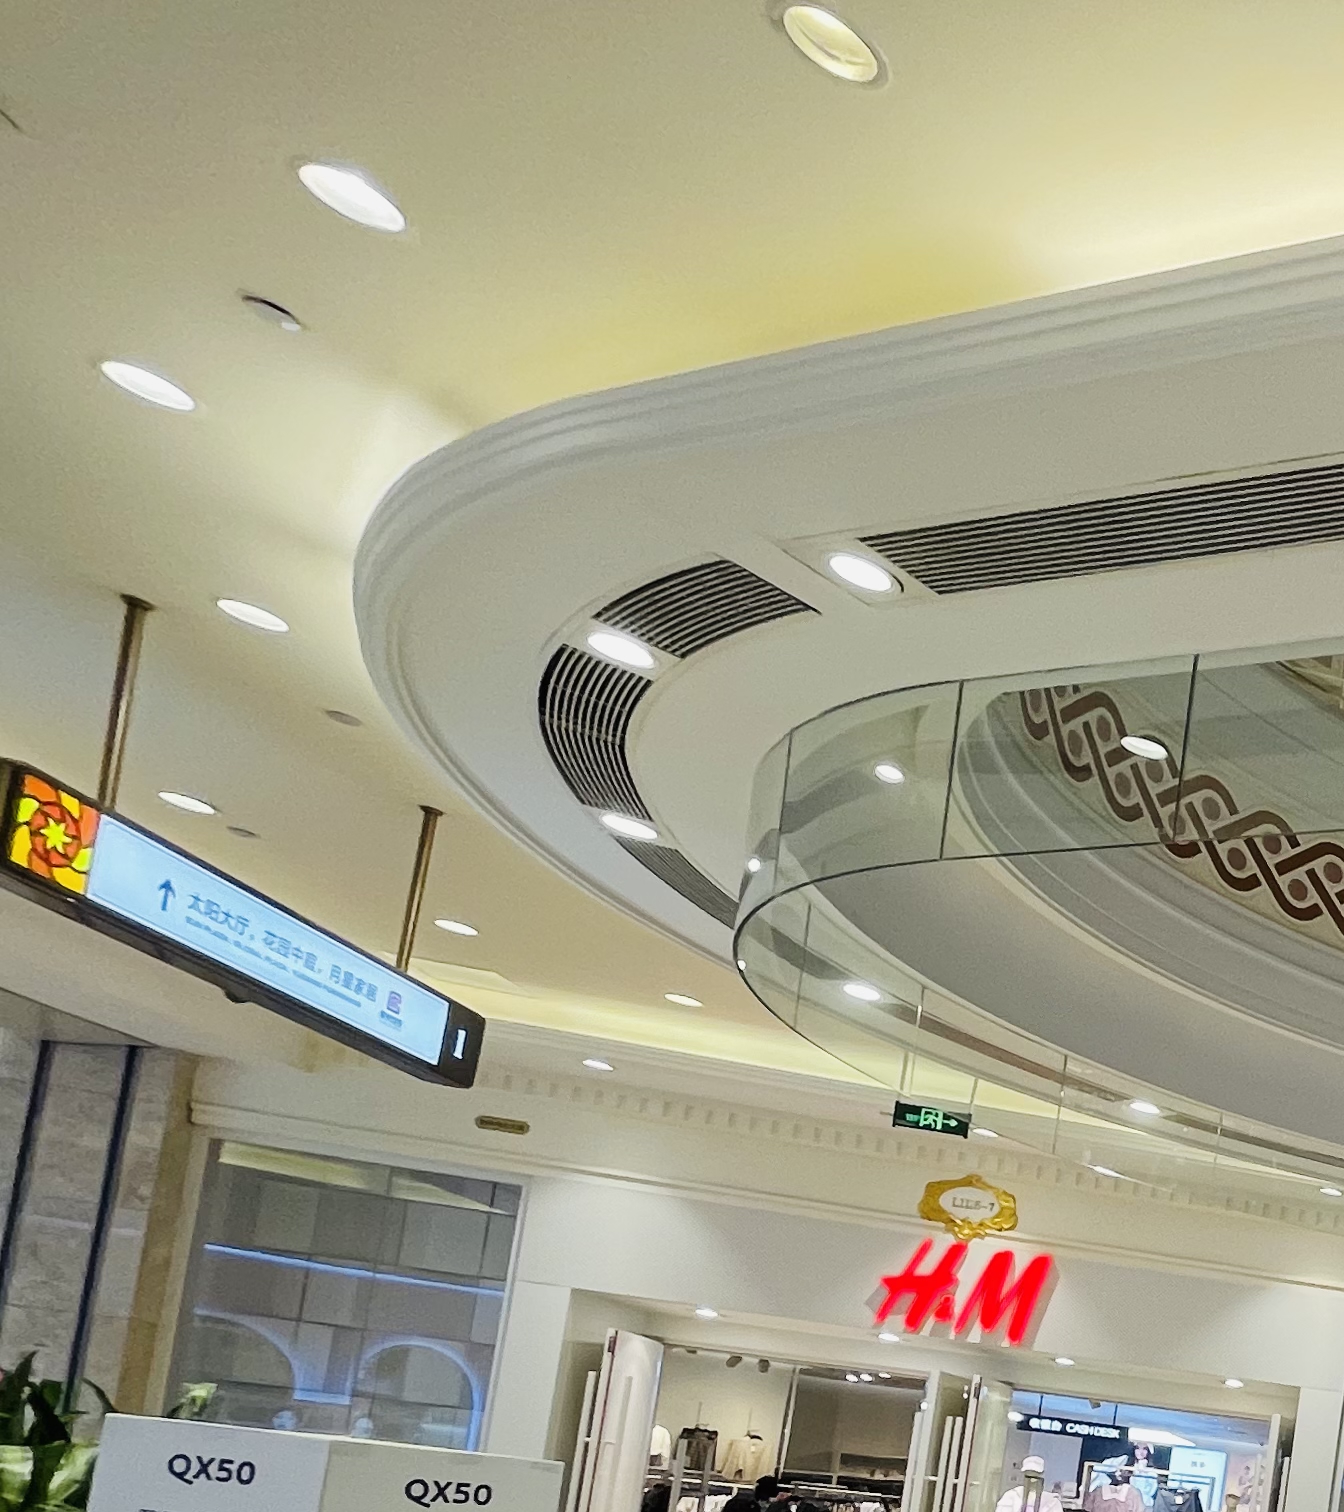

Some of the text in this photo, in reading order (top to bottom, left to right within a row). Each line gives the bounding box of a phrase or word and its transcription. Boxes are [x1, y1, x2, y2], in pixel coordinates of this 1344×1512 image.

[874, 1238, 1055, 1345] H&M
[167, 1453, 256, 1486] QX50
[404, 1478, 493, 1509] QX50
